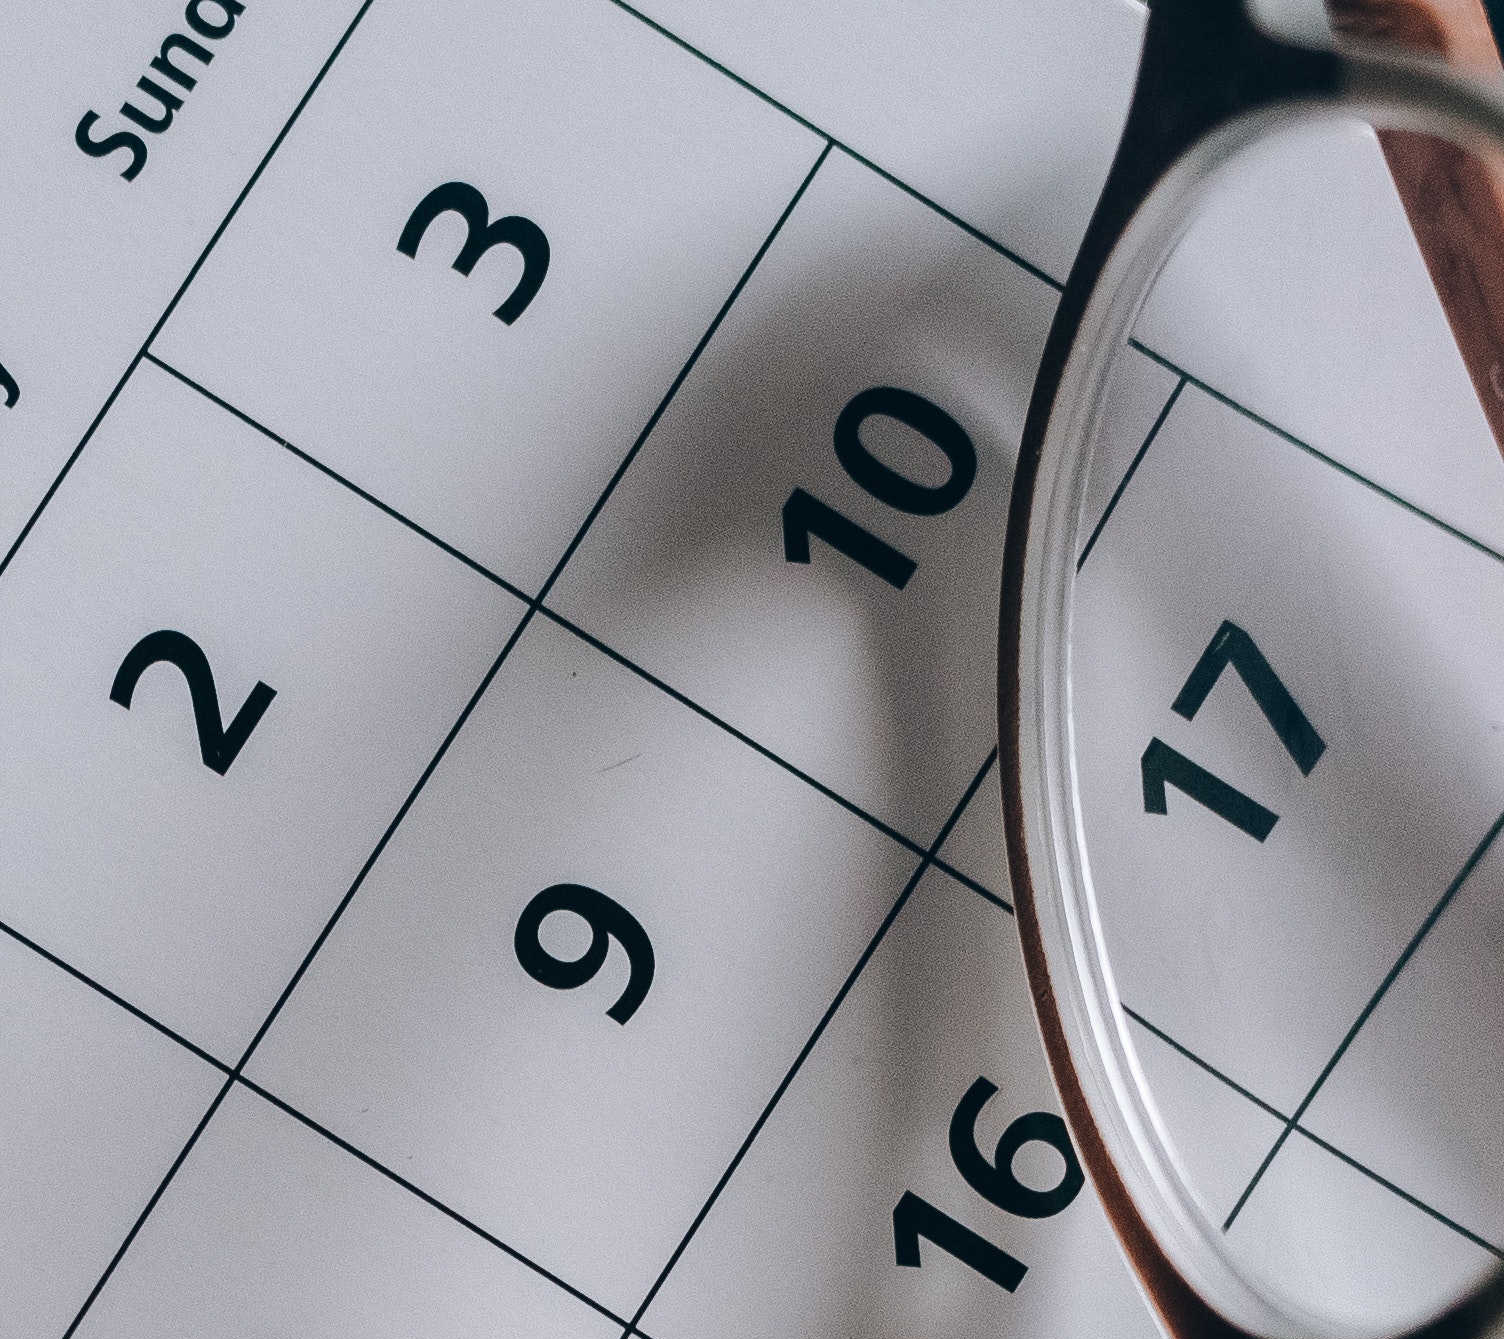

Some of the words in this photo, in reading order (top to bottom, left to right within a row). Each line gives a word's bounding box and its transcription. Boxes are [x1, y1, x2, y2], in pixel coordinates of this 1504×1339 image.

[397, 182, 550, 326] 3
[781, 385, 980, 591] 10
[110, 630, 277, 776] 2
[1141, 620, 1327, 843] 17
[514, 884, 655, 1025] 9
[893, 1076, 1085, 1293] 16
